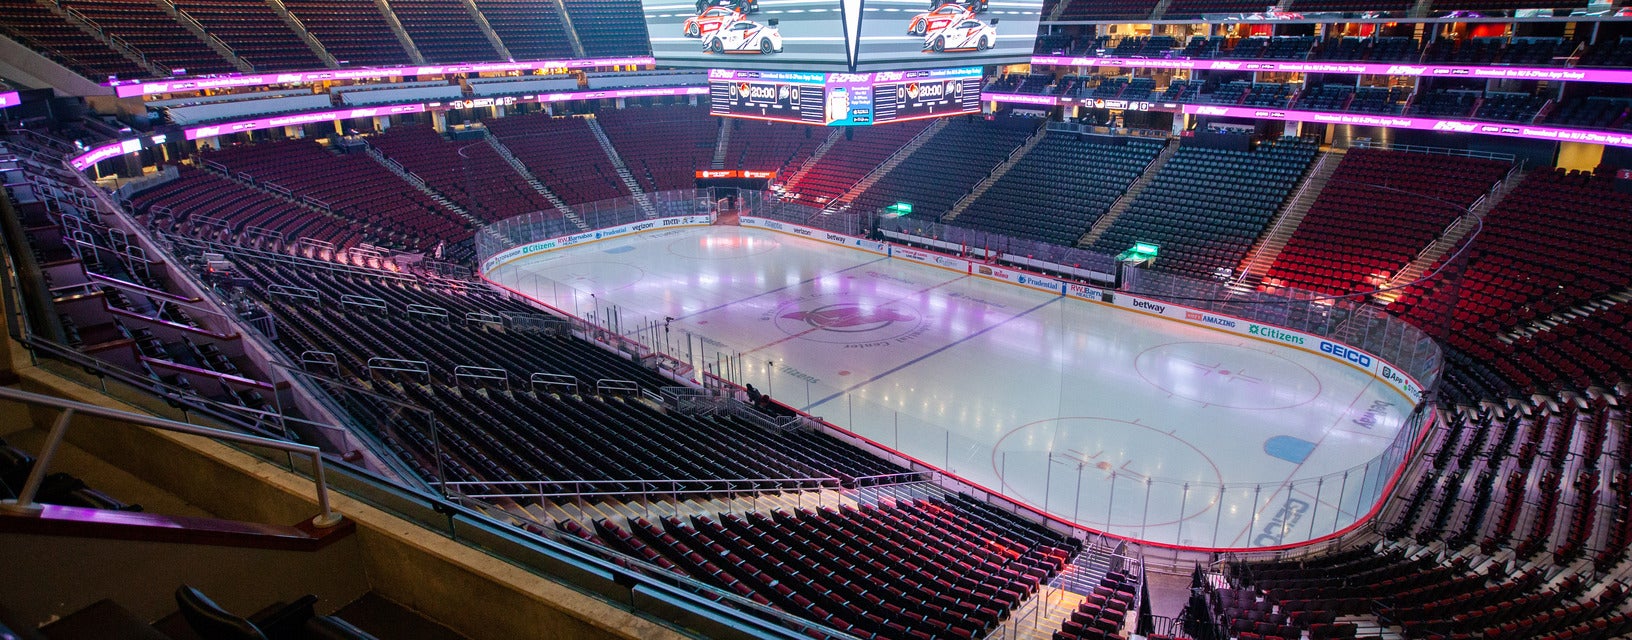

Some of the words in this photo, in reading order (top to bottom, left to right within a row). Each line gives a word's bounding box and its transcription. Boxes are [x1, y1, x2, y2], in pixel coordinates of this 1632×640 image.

[730, 85, 736, 95] 0
[751, 87, 775, 99] 20:00
[898, 88, 904, 98] 0
[920, 85, 942, 97] 20:00
[956, 83, 961, 92] 0
[792, 89, 798, 99] 0
[1523, 128, 1558, 138] Download
[1606, 136, 1621, 144] App
[603, 226, 626, 237] Prudential
[632, 222, 654, 231] verizon
[793, 228, 812, 236] verizon
[826, 233, 846, 244] betway
[529, 242, 556, 252] Citizens
[1028, 278, 1058, 290] Prudential
[1133, 298, 1166, 314] betway
[1202, 316, 1236, 328] AMAZING
[1260, 328, 1304, 345] Citizens
[1320, 341, 1371, 368] GEICO
[1390, 372, 1402, 384] App
